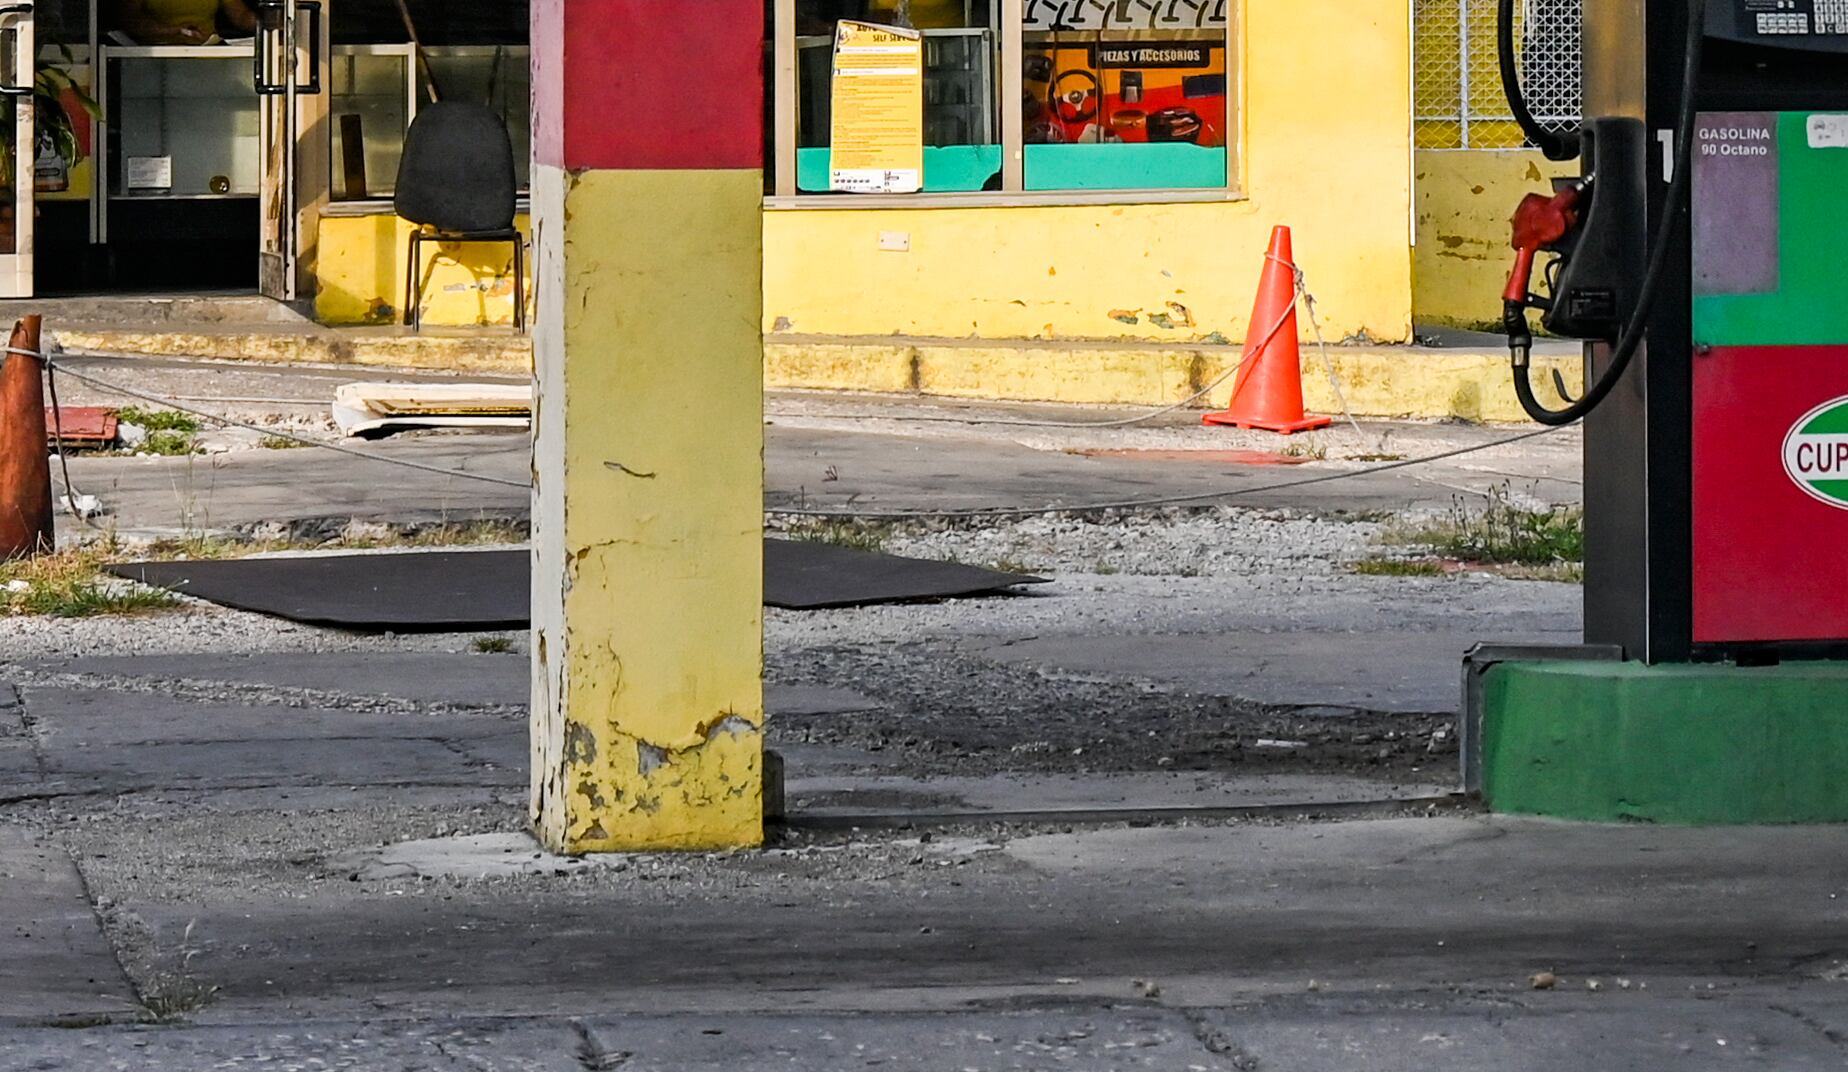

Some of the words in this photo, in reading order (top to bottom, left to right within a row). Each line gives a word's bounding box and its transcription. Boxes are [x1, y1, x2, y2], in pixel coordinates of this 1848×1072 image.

[1131, 50, 1138, 62] Y
[1139, 49, 1200, 61] ACCESORIOS
[1699, 127, 1770, 142] GASOLINA
[1657, 128, 1674, 184] 1
[1701, 143, 1718, 157] 90
[1721, 142, 1768, 157] Octano
